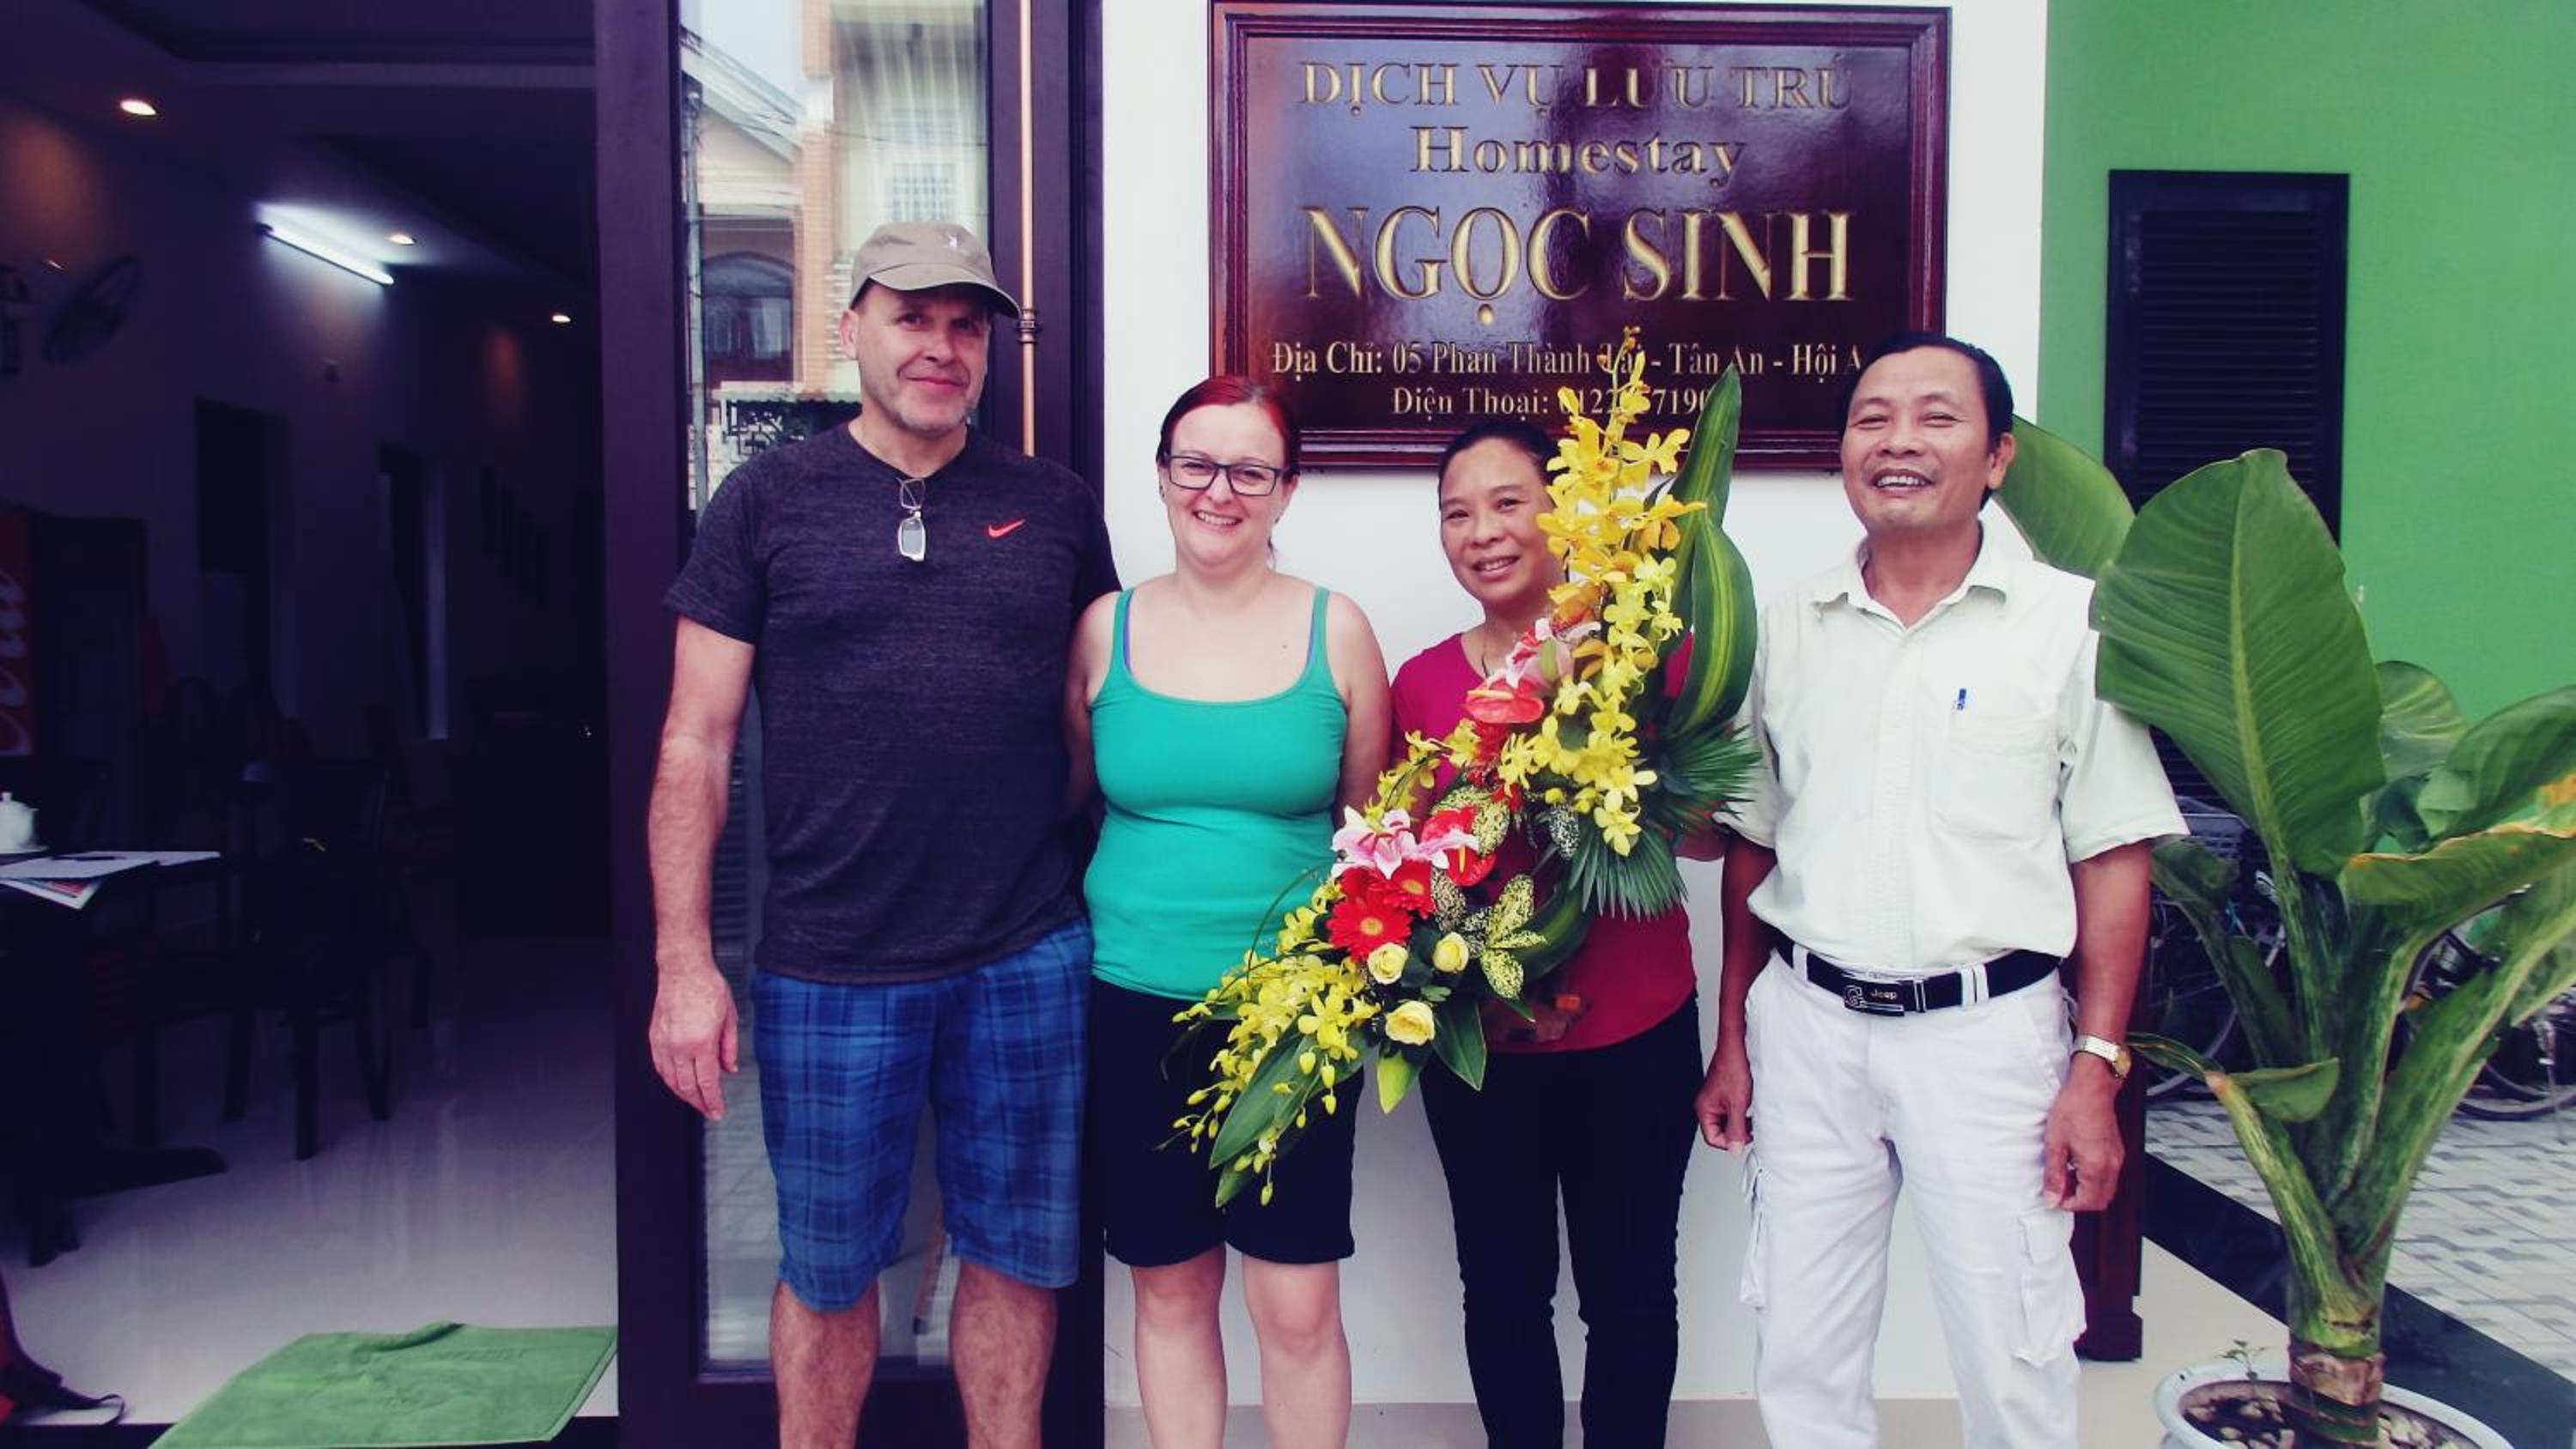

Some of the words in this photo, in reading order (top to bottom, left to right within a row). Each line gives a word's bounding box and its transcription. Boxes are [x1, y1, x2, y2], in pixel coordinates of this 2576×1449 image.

[1296, 61, 1461, 117] DỊCH
[1477, 64, 1564, 118] VỤ
[1729, 53, 1853, 111] TRÚ
[1409, 125, 1747, 189] Homestay
[1298, 205, 1591, 327] NGỌC
[1623, 207, 1855, 302] SINH
[1272, 341, 1318, 382] Địa
[1393, 342, 1423, 375] 05
[1431, 341, 1498, 375] Phan
[1510, 341, 1589, 375] Thành
[1668, 342, 1718, 375] Tân
[1729, 343, 1765, 376] An
[1792, 341, 1838, 384] Hội
[1392, 386, 1455, 421] Điện
[1462, 386, 1549, 421] Thoại:
